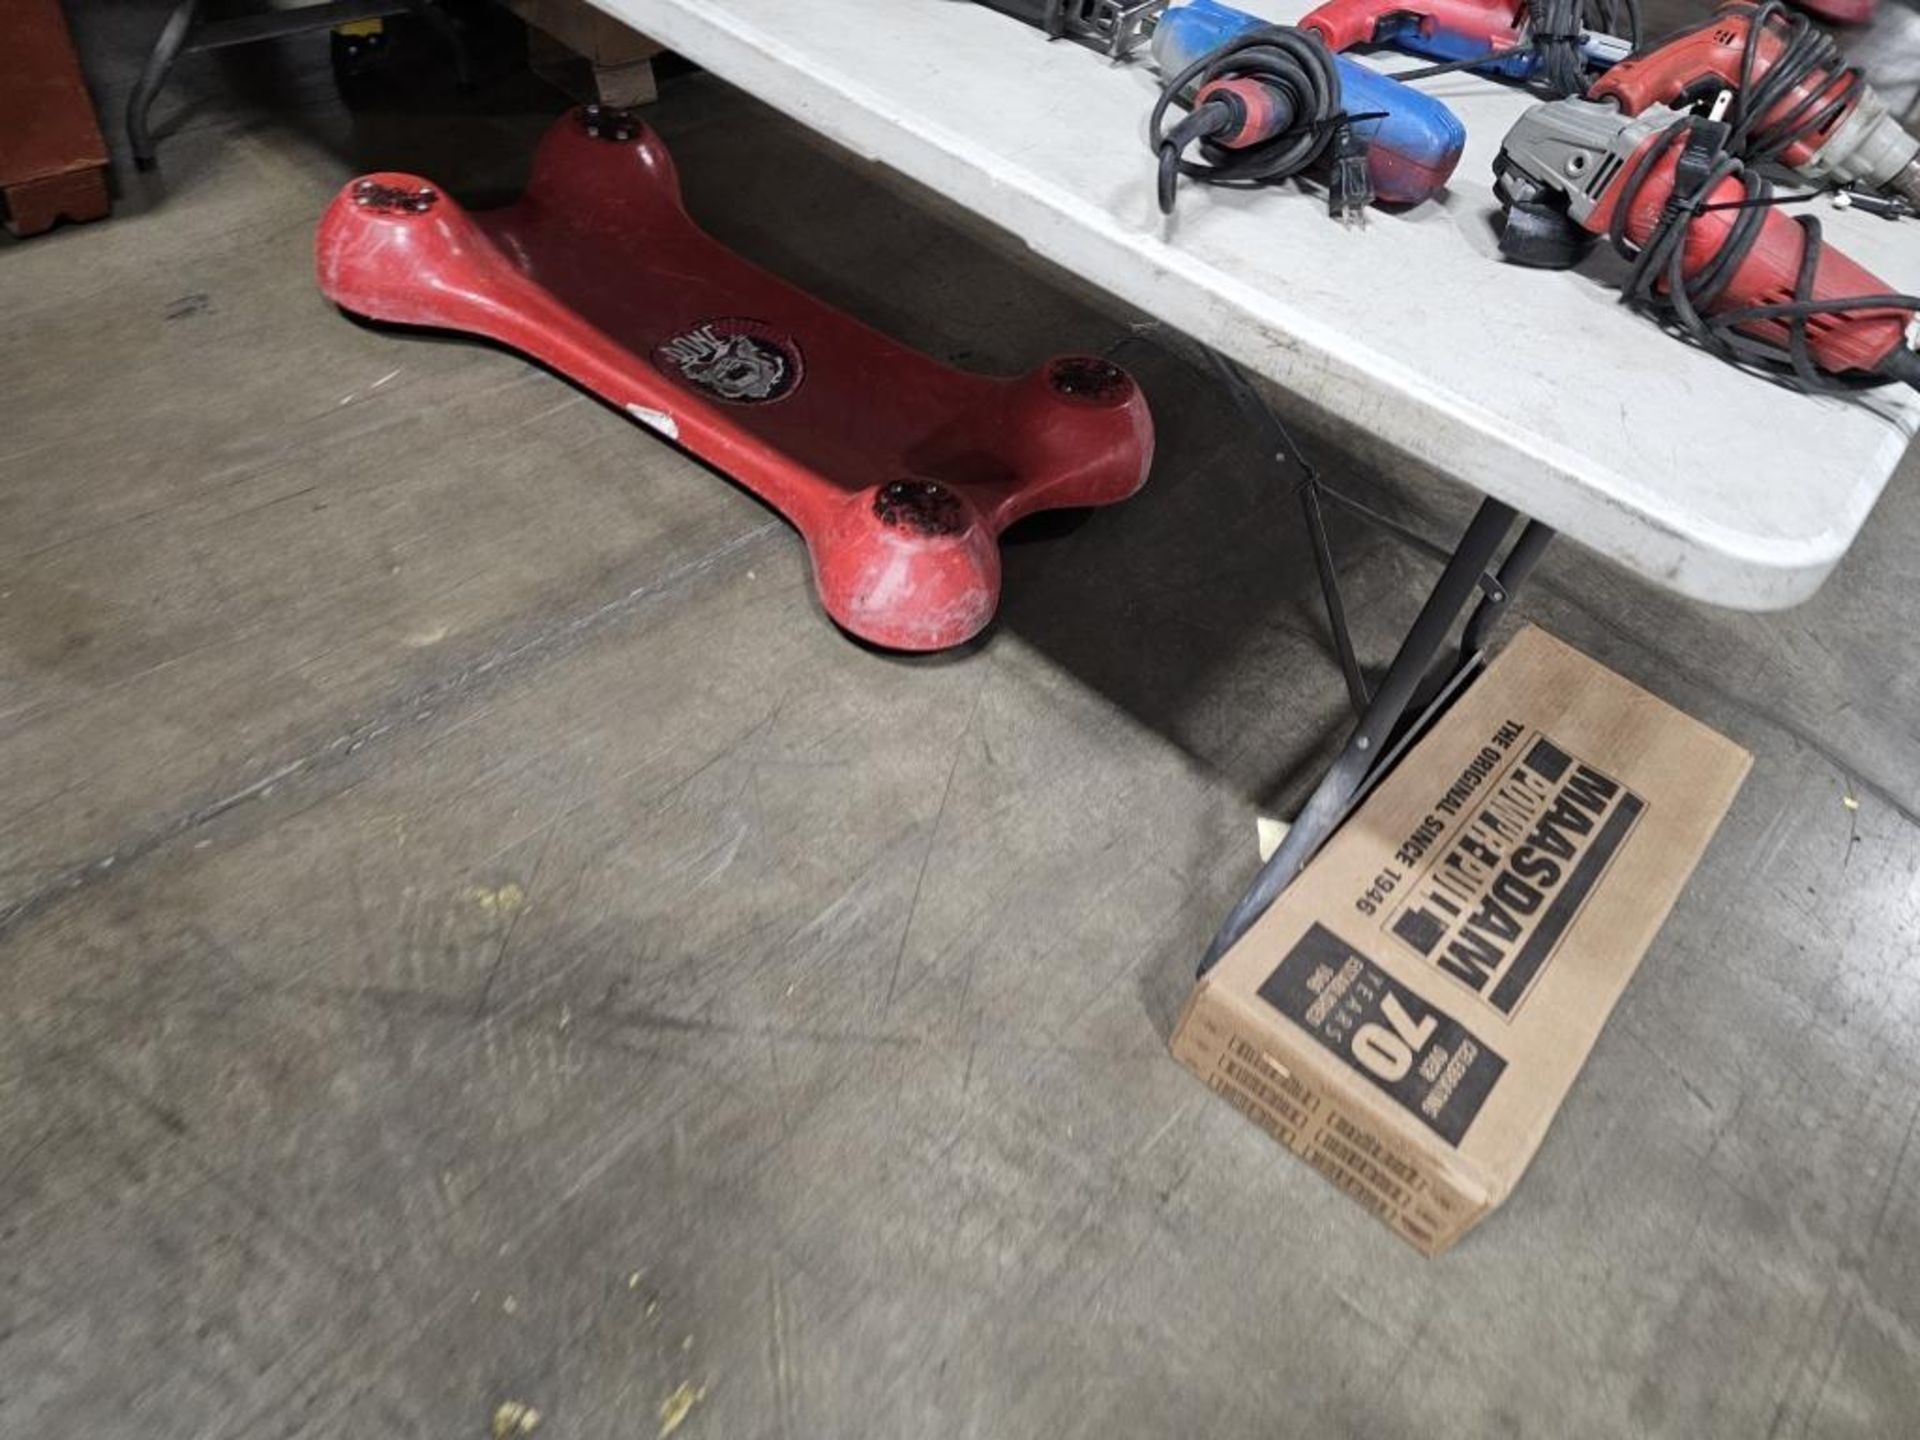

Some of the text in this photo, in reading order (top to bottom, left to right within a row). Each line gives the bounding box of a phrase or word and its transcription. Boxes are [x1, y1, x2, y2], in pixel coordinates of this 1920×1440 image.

[1352, 718, 1524, 917] THE ORIGINAL SINCE 1946
[1434, 763, 1620, 993] MAASDAM
[1320, 969, 1385, 1043] YEARS
[1350, 988, 1440, 1086] 70
